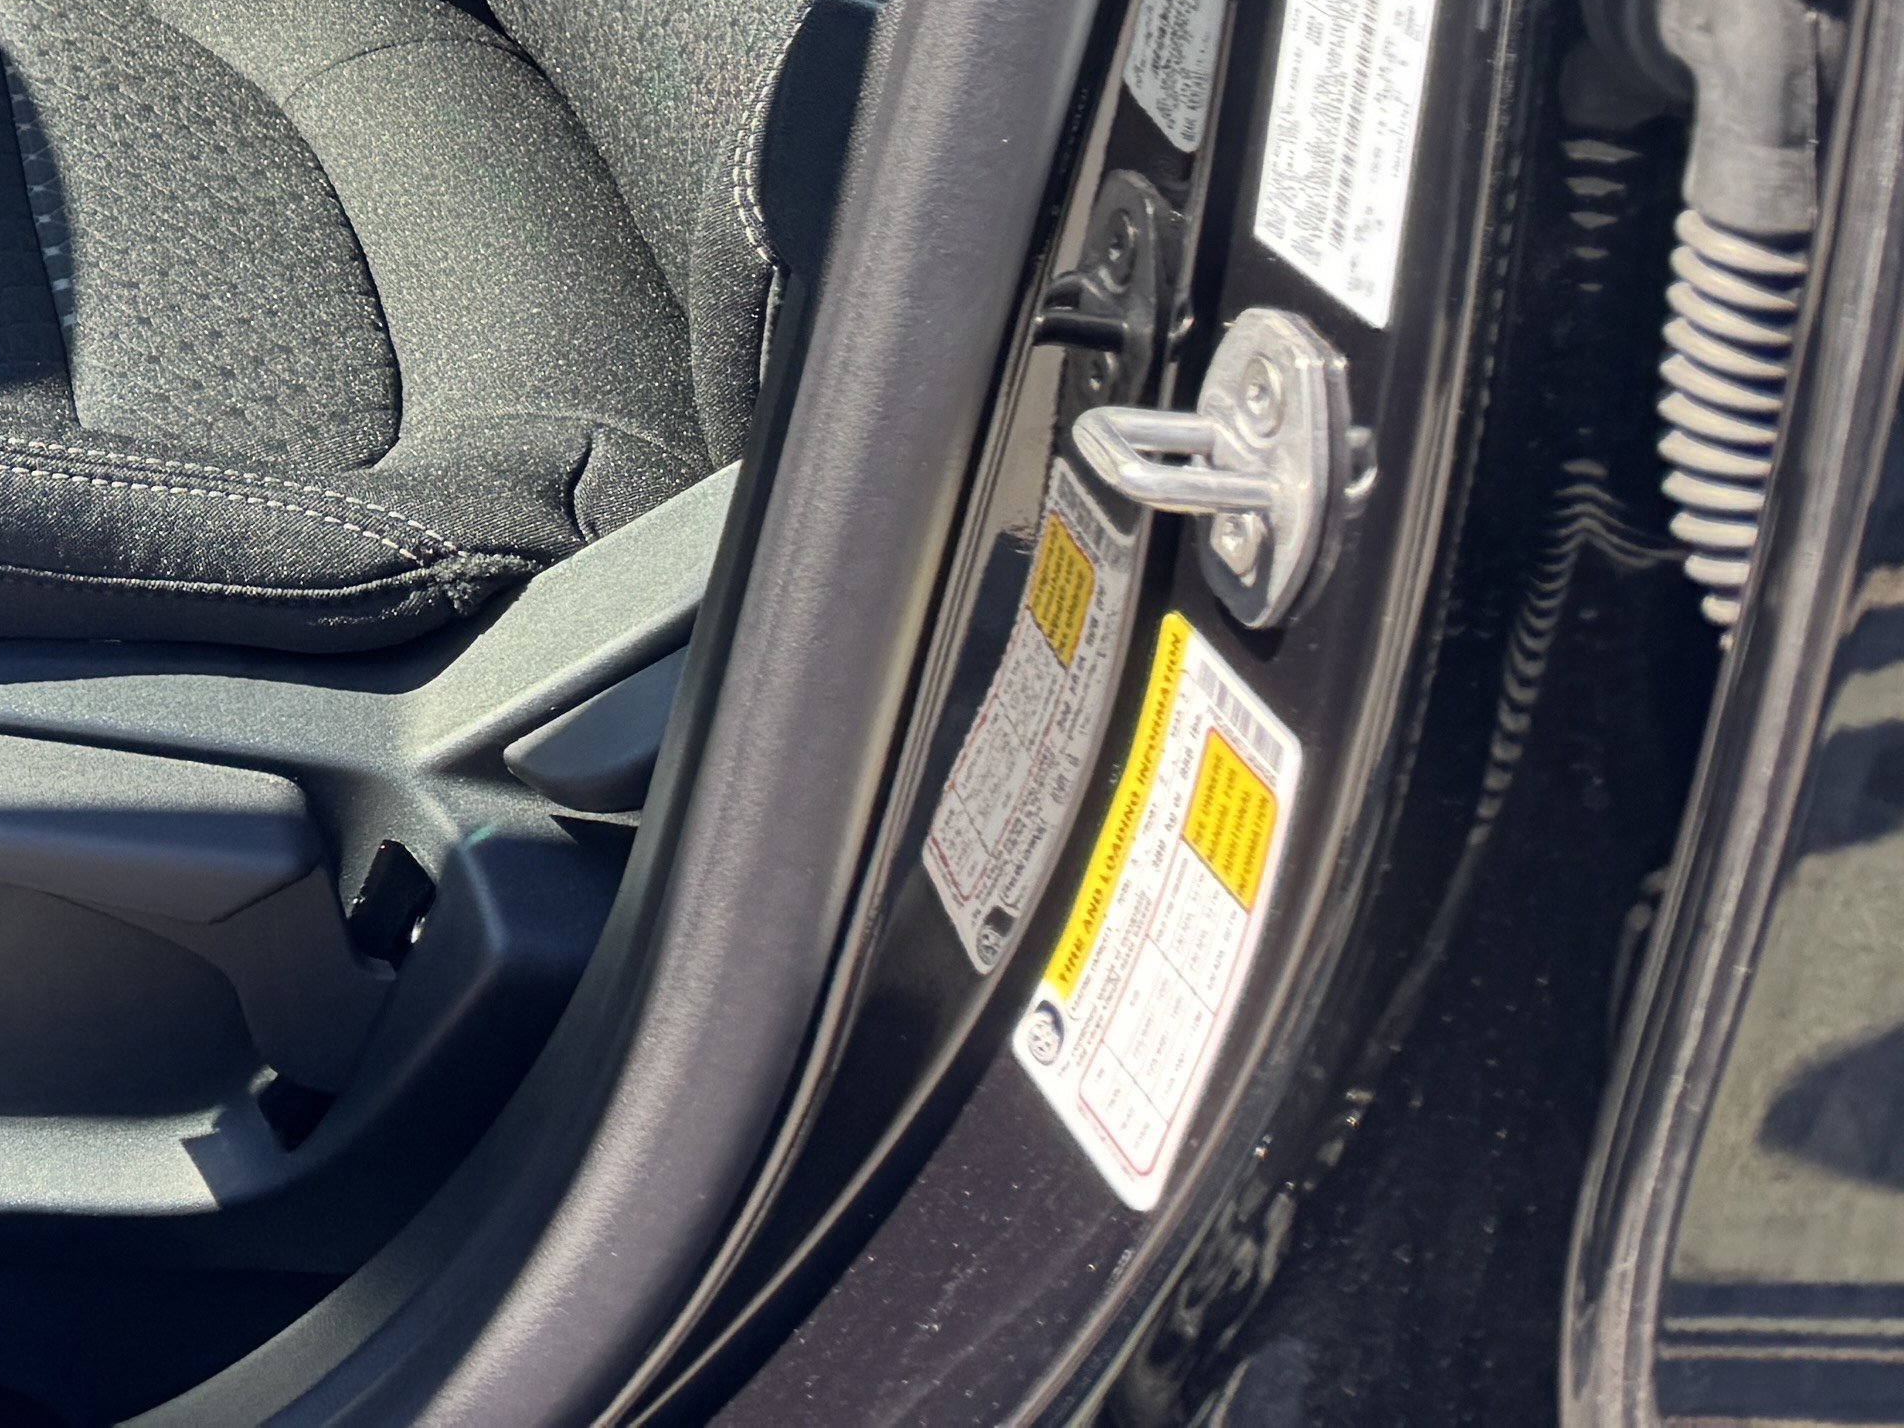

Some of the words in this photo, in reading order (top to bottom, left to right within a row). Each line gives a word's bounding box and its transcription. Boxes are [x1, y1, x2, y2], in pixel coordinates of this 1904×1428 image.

[1057, 935, 1087, 985] TIRE
[1080, 886, 1106, 935] AND
[1097, 789, 1142, 886] LOADING
[1136, 631, 1183, 786] INFORMATION
